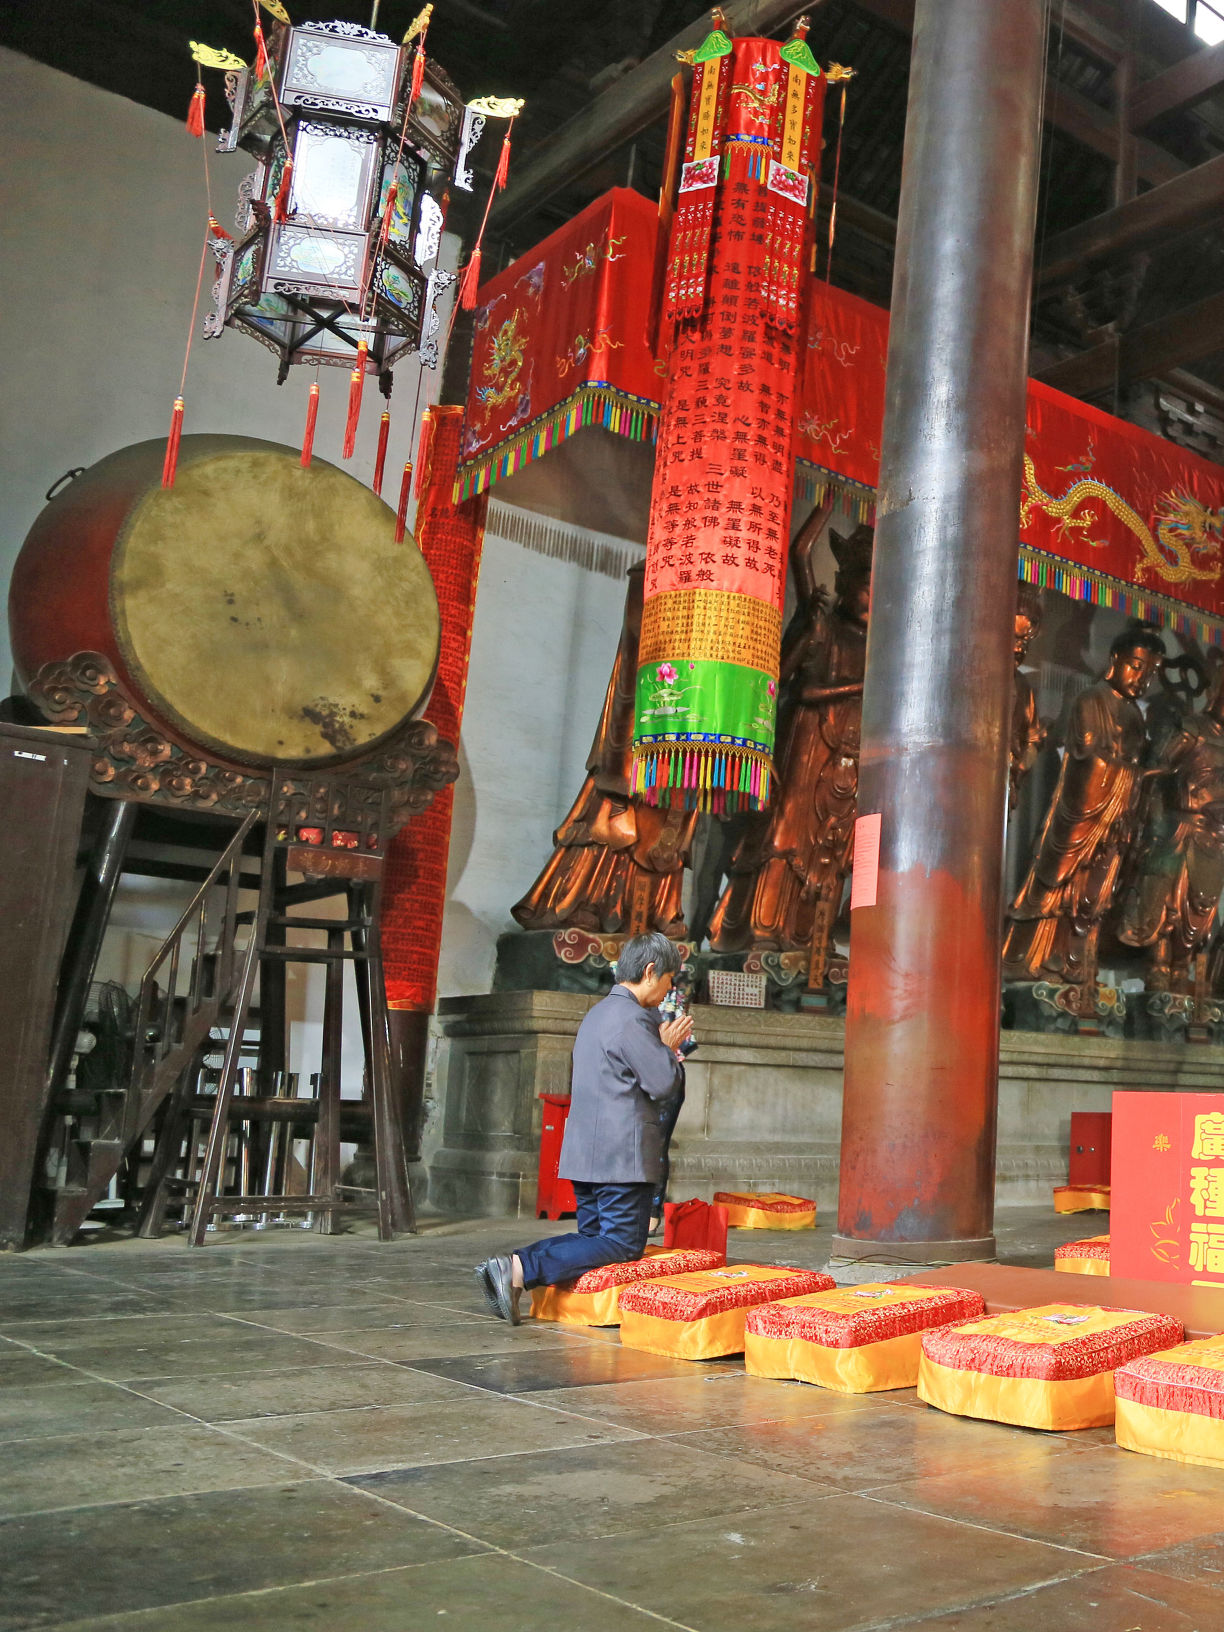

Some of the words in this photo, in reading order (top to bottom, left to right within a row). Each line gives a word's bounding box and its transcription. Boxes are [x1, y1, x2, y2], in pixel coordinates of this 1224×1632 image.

[728, 182, 750, 241] 無有恐怖
[670, 399, 691, 464] 是無上咒
[660, 485, 683, 569] 是無等等咒
[678, 483, 701, 584] 故知般若波羅
[701, 463, 725, 529] 三世諸佛
[744, 486, 766, 572] 以無所得故
[761, 493, 782, 578] 乃至無老死
